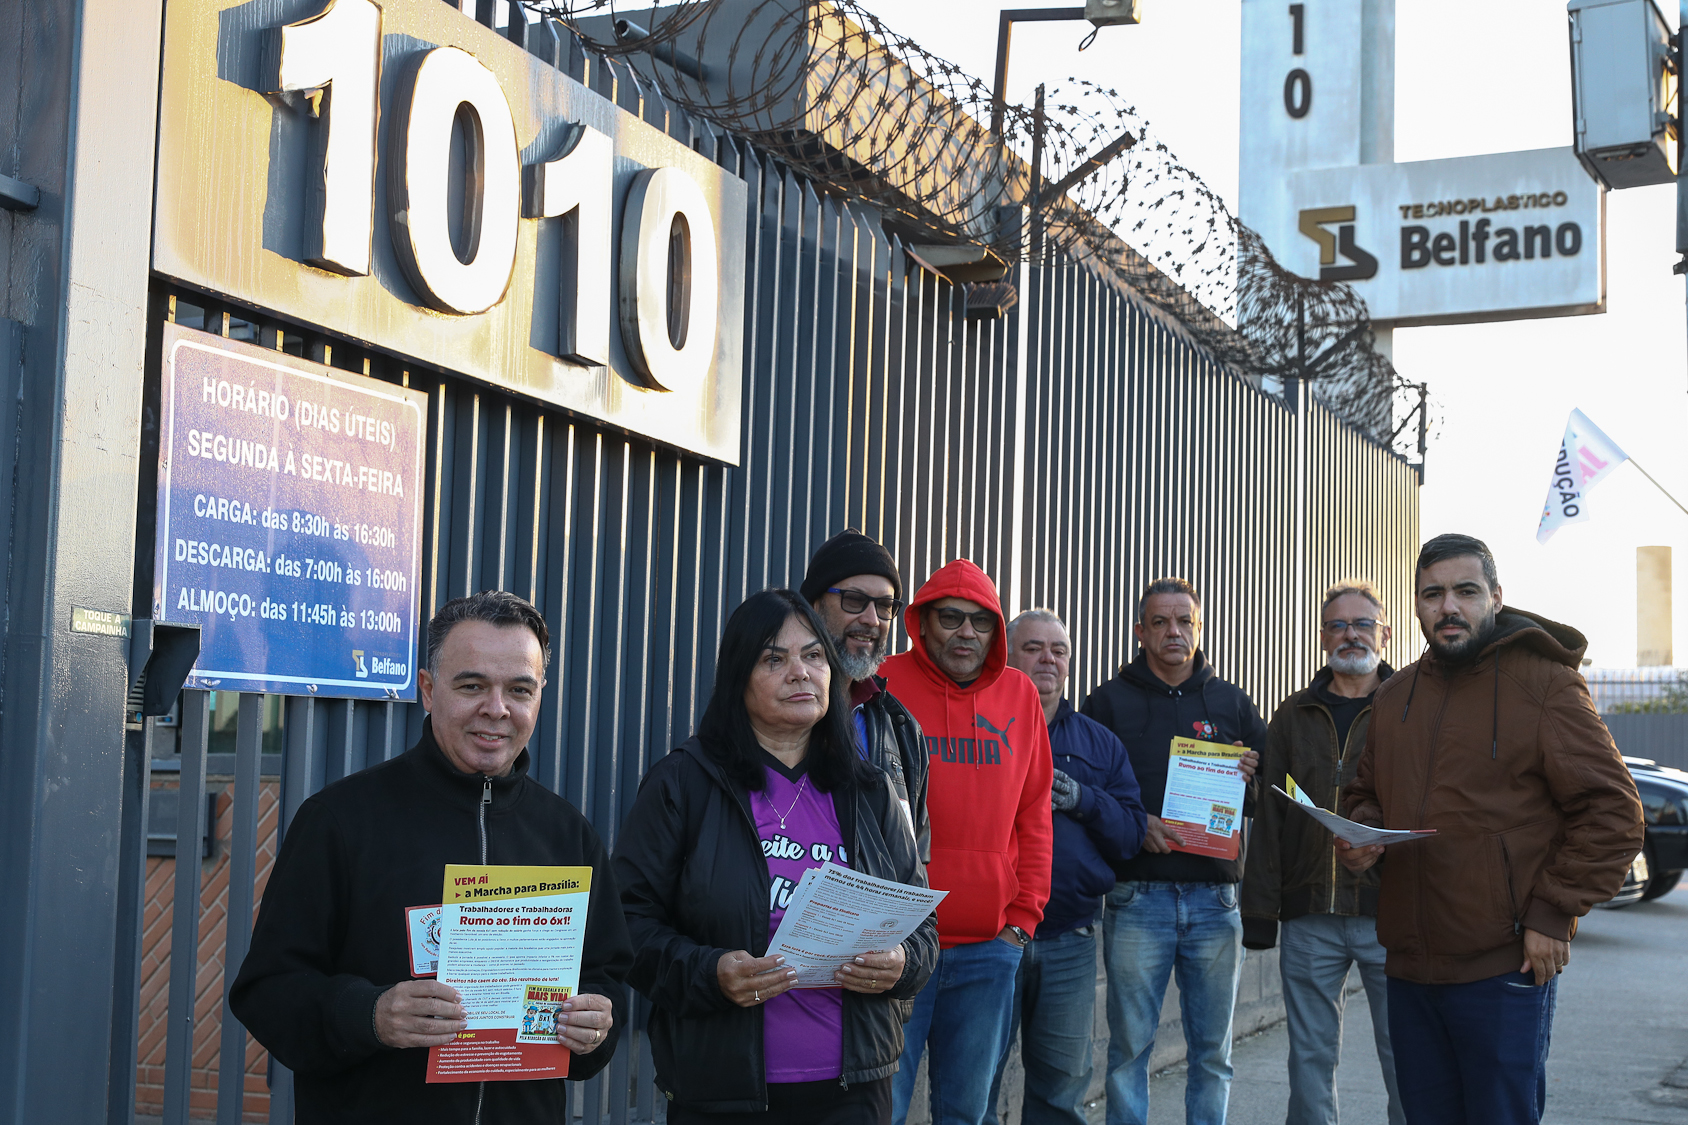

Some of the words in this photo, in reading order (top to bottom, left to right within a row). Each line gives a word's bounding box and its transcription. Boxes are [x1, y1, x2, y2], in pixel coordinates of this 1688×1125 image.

[262, 0, 718, 392] 1010
[1399, 190, 1568, 219] TECNOPLASTICO
[1400, 217, 1583, 270] Belfano
[203, 376, 290, 421] HORÁRIO
[295, 399, 340, 433] (DIAS
[345, 406, 396, 453] ÚTEIS)
[187, 428, 280, 473] SEGUNDA
[283, 443, 297, 476] À
[301, 453, 404, 498] SEXTA-FEIRA
[193, 494, 257, 526] CARGA:
[261, 506, 288, 531] das
[292, 511, 330, 538] 8:30h
[333, 517, 350, 541] às
[353, 522, 396, 549] 16:30h
[175, 538, 271, 574] DESCARGA:
[275, 553, 301, 578] das
[305, 558, 342, 583] 7:00h
[345, 561, 362, 586] às
[365, 567, 407, 592] 16:00h
[83, 610, 112, 623] TOQUE
[115, 614, 121, 625] A
[177, 586, 257, 621] ALMOÇO:
[260, 597, 287, 620] das
[291, 601, 336, 627] 11:45h
[339, 605, 356, 628] às
[359, 609, 402, 633] 13:00h
[75, 621, 128, 637] CAMPAINHA
[371, 656, 407, 676] Belfano
[924, 736, 1001, 765] PUMA
[812, 843, 832, 861] a
[454, 876, 476, 886] VEM
[478, 873, 489, 885] AÍ
[465, 890, 471, 898] a
[473, 886, 512, 897] Marcha
[514, 884, 537, 896] para
[539, 879, 580, 891] Brasília:
[825, 875, 846, 884] menos
[882, 892, 910, 901] semanais,
[828, 869, 842, 877] 75%
[855, 878, 896, 891] trabalhadores
[904, 890, 933, 898] trabalham
[459, 905, 514, 913] Trabalhadores
[810, 900, 832, 909] Propostas
[420, 911, 434, 924] Fim
[459, 916, 494, 926] Rumo
[495, 917, 510, 926] ao
[511, 915, 531, 926] fim
[533, 915, 548, 926] do
[549, 916, 571, 926] 6x1!
[527, 991, 548, 1001] MAIS
[551, 992, 568, 1001] VIDA
